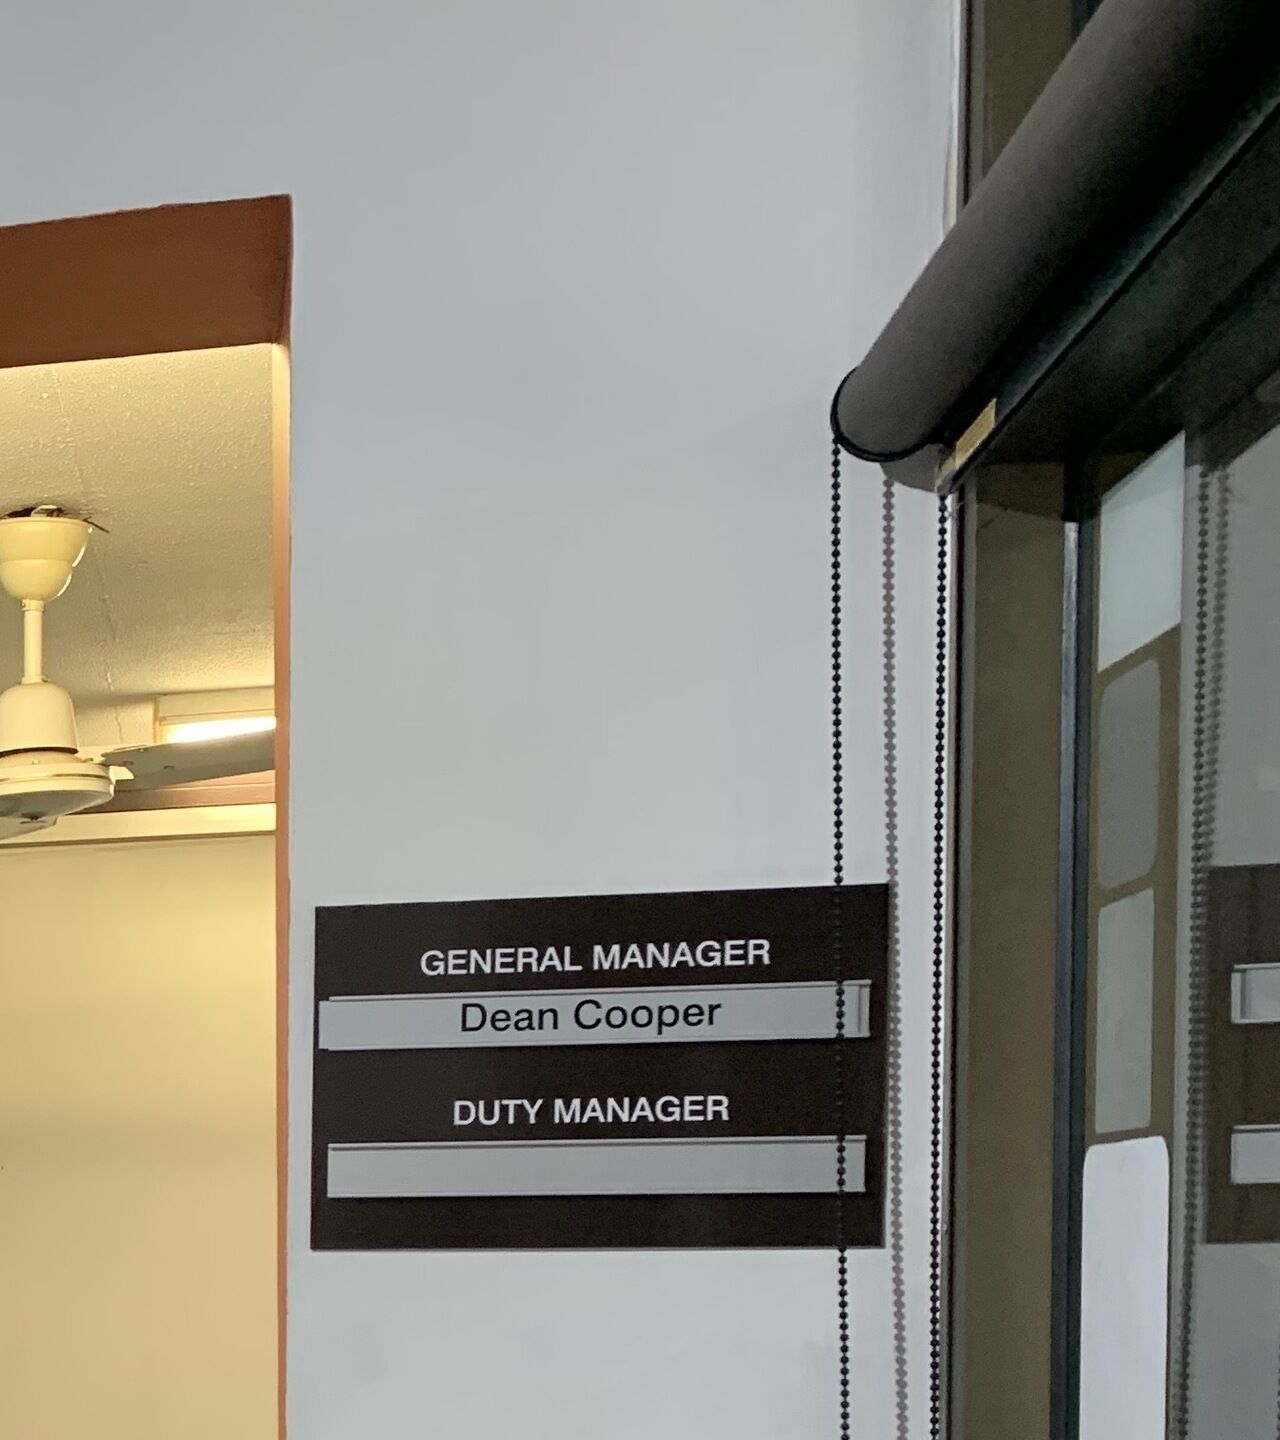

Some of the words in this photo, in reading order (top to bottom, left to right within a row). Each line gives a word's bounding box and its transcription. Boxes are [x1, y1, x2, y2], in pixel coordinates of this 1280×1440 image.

[420, 946, 582, 975] GENERAL
[592, 939, 771, 971] MANAGER
[461, 1002, 559, 1032] Dean
[573, 999, 722, 1036] Cooper
[453, 1099, 543, 1126] DUTY
[553, 1096, 729, 1123] MANAGER
